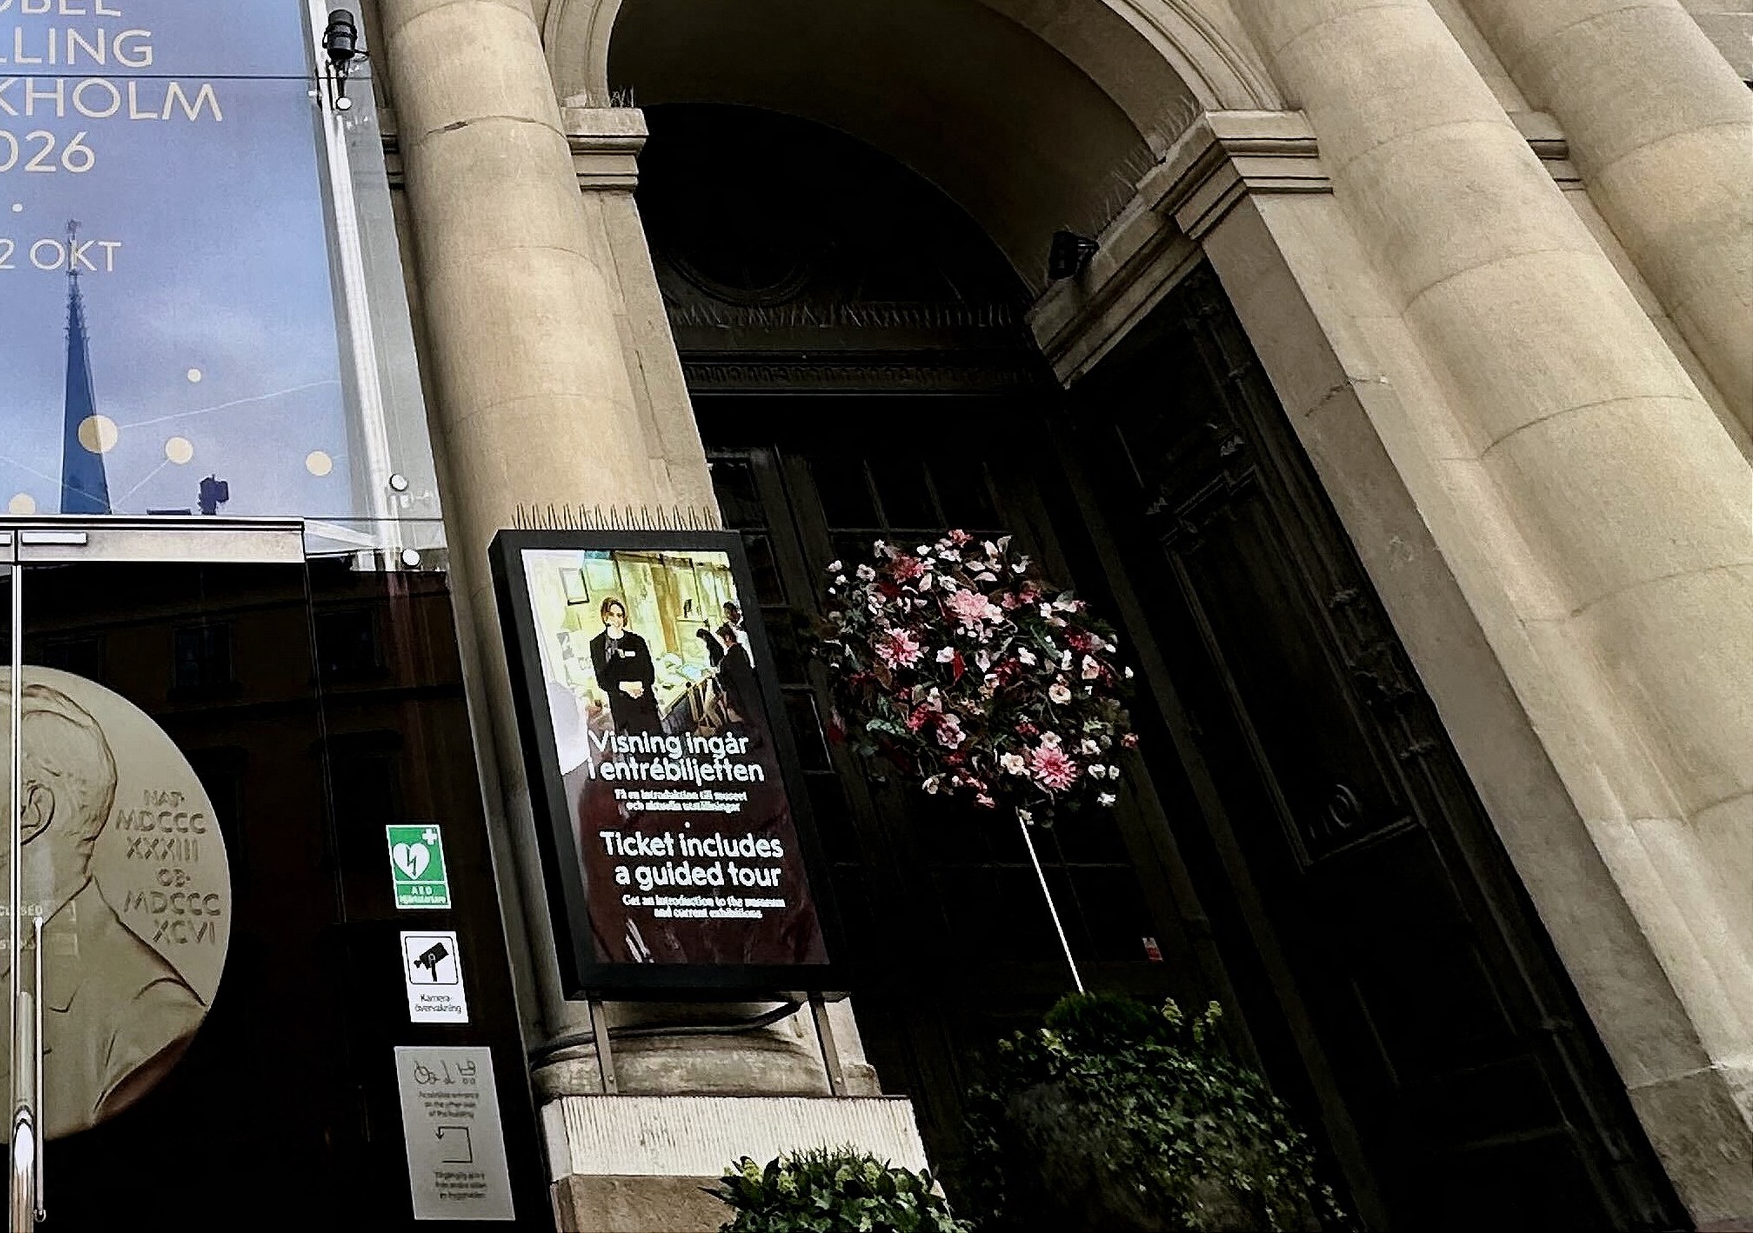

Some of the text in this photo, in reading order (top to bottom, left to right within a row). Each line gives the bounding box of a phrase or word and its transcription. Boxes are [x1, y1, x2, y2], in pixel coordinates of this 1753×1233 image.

[29, 239, 121, 272] OKT
[588, 730, 749, 759] Visning ingår
[587, 757, 765, 786] i entrébiljetten
[115, 809, 207, 835] MDCCC
[126, 837, 199, 862] XXXIII
[599, 831, 784, 858] Ticket includes
[615, 861, 782, 891] a guided tour
[124, 891, 221, 916] MDCCC
[152, 919, 216, 945] XCVI
